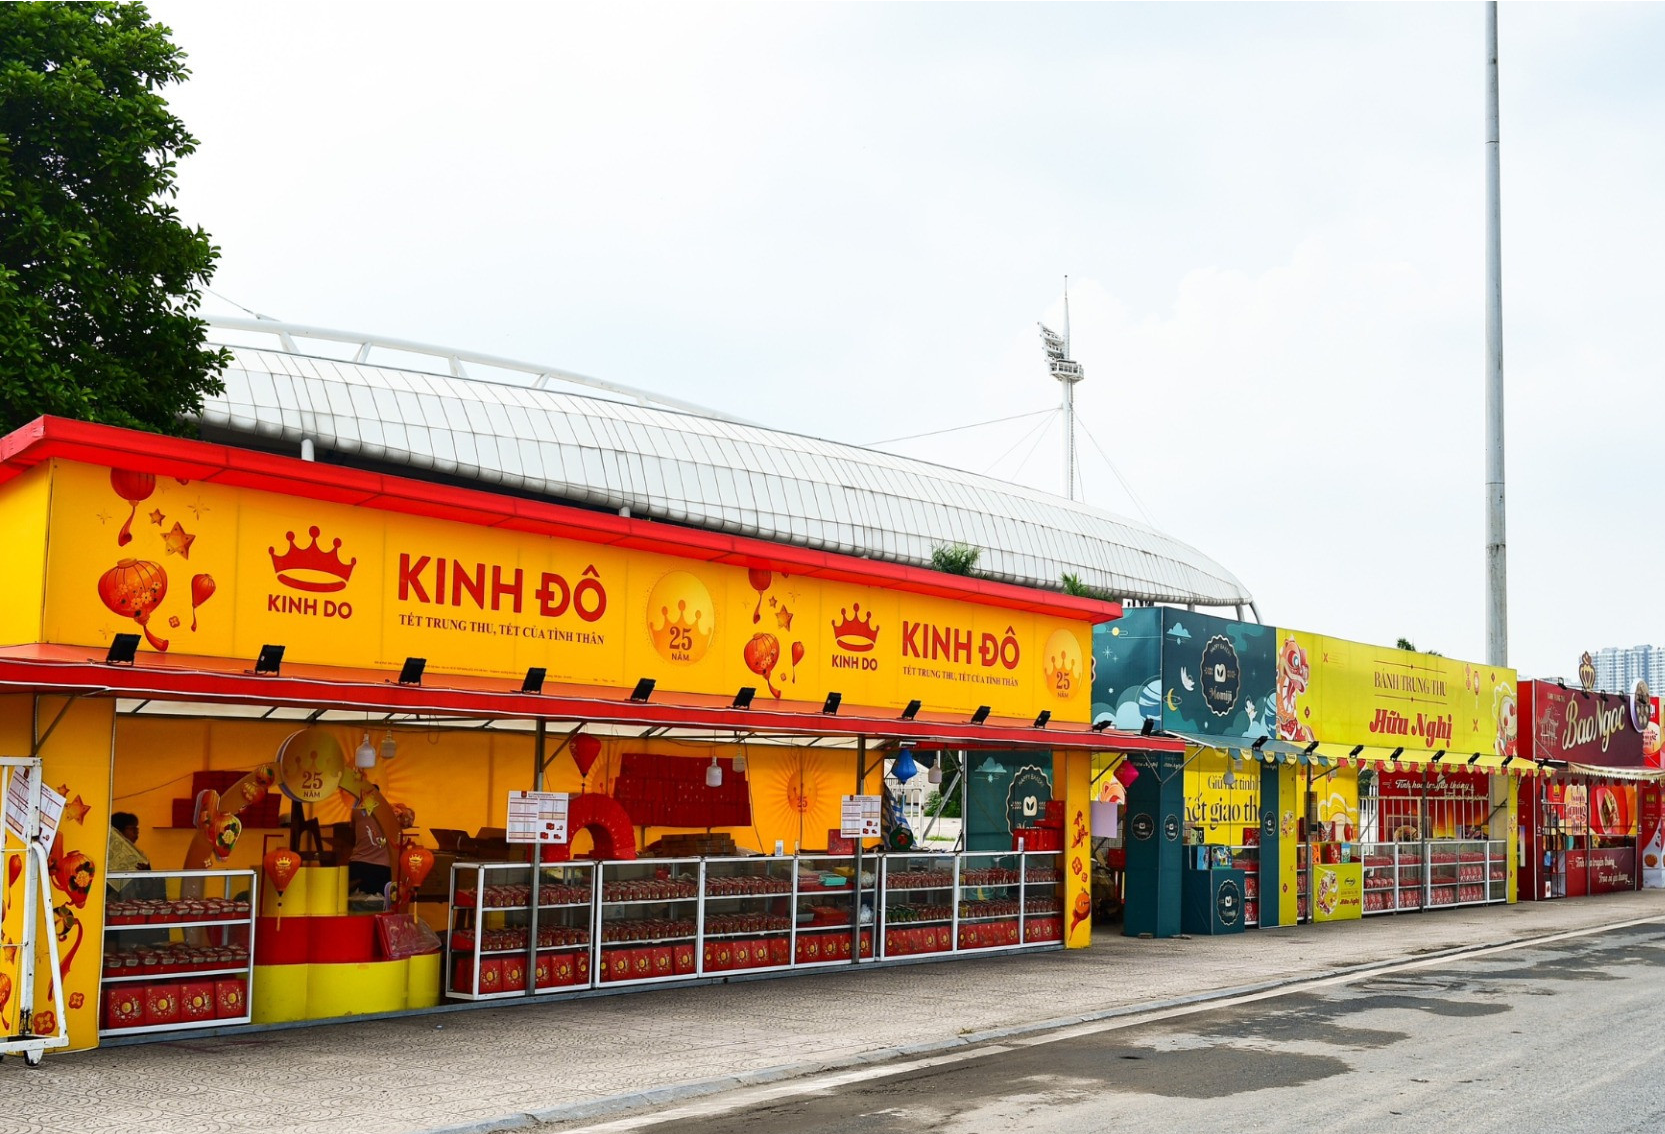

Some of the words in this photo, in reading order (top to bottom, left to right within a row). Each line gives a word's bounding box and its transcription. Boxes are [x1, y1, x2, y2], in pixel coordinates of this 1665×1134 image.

[398, 553, 523, 613] KINH
[535, 564, 607, 622] ĐÔ
[268, 594, 317, 616] KINH
[324, 600, 352, 619] DO
[399, 612, 423, 627] TẾT
[426, 617, 467, 632] TRUNG
[470, 621, 497, 635] THU,
[499, 623, 519, 637] TẾT
[523, 624, 545, 639] CỦA
[548, 627, 573, 642] TÌNH
[576, 630, 604, 645] THÂN
[669, 626, 693, 650] 25
[671, 650, 690, 662] NĂM
[902, 621, 972, 665] KINH
[978, 625, 1020, 670] ĐÔ
[832, 654, 859, 670] KINH
[861, 656, 878, 671] DO
[917, 667, 941, 680] TRUNG
[1056, 671, 1070, 690] 25
[1375, 667, 1399, 690] BÁNH
[1402, 674, 1429, 694] TRUNG
[1432, 679, 1447, 697] THU
[1369, 708, 1409, 735] Hữu
[1411, 713, 1452, 749] Nghị
[302, 771, 323, 789] 25
[304, 789, 320, 798] NĂM
[1210, 796, 1240, 830] giao
